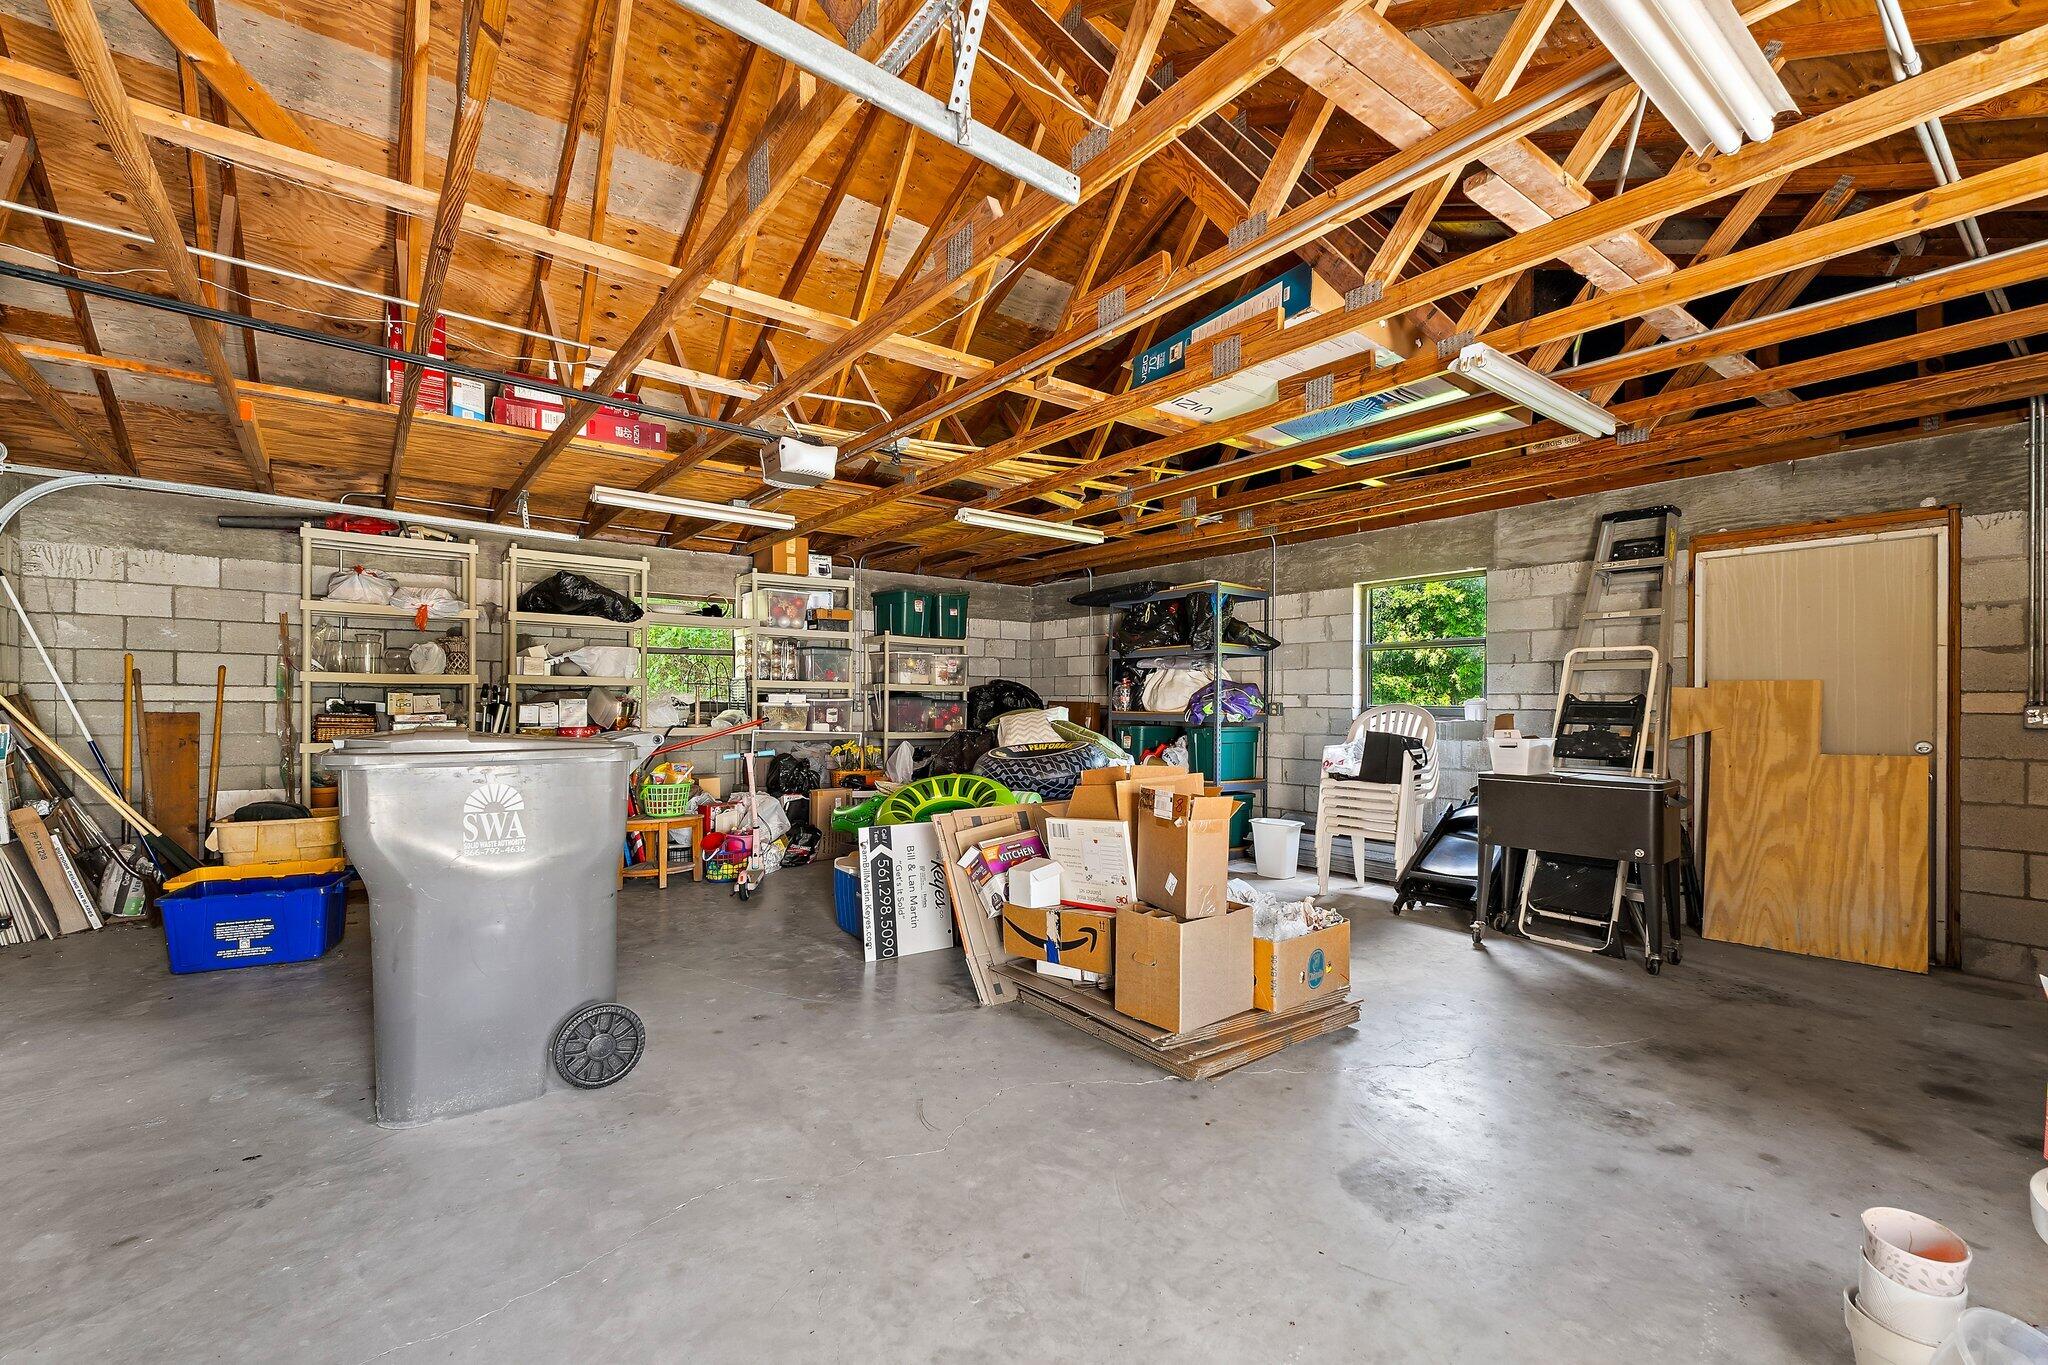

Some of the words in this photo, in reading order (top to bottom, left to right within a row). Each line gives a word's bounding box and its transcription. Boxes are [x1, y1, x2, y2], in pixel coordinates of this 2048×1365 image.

[1141, 354, 1149, 383] VIZIO
[1171, 397, 1215, 416] VIZI
[463, 811, 527, 842] SWA
[906, 845, 916, 861] Bill
[999, 846, 1035, 862] KITCHEN
[907, 863, 916, 872] &
[860, 839, 873, 950] TeamBillMartin.Keyes.com
[908, 874, 917, 893] Lan
[877, 859, 895, 958] 561.298.5090
[909, 895, 920, 929] Martin
